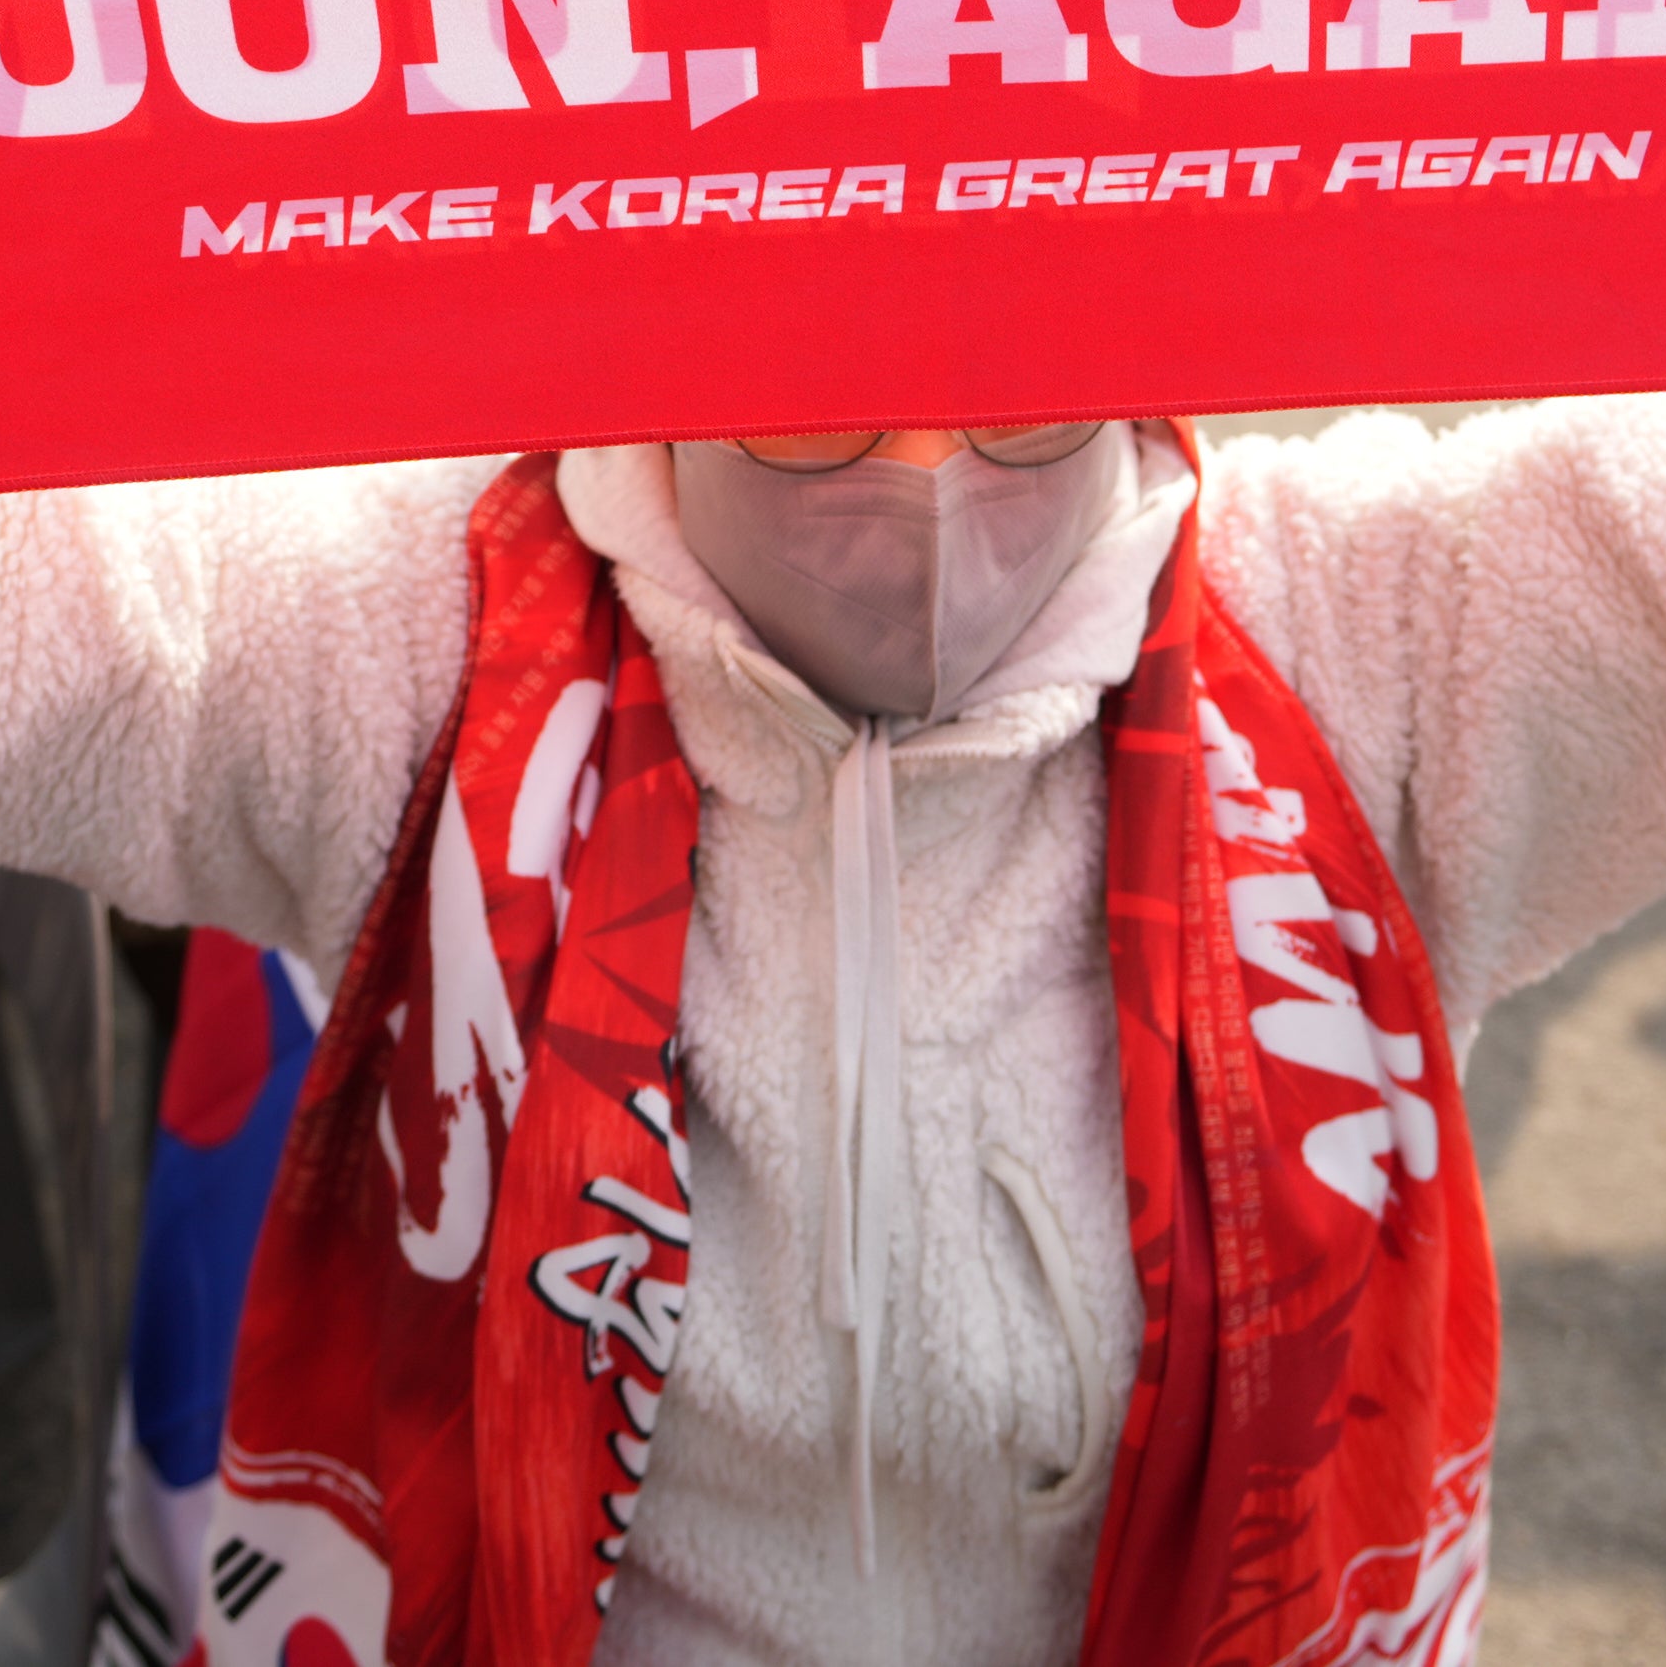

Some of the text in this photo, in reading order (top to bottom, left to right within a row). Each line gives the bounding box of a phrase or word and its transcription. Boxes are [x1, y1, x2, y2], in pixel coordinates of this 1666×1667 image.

[181, 131, 1651, 257] MAKE KOREA GREAT AGAIN
